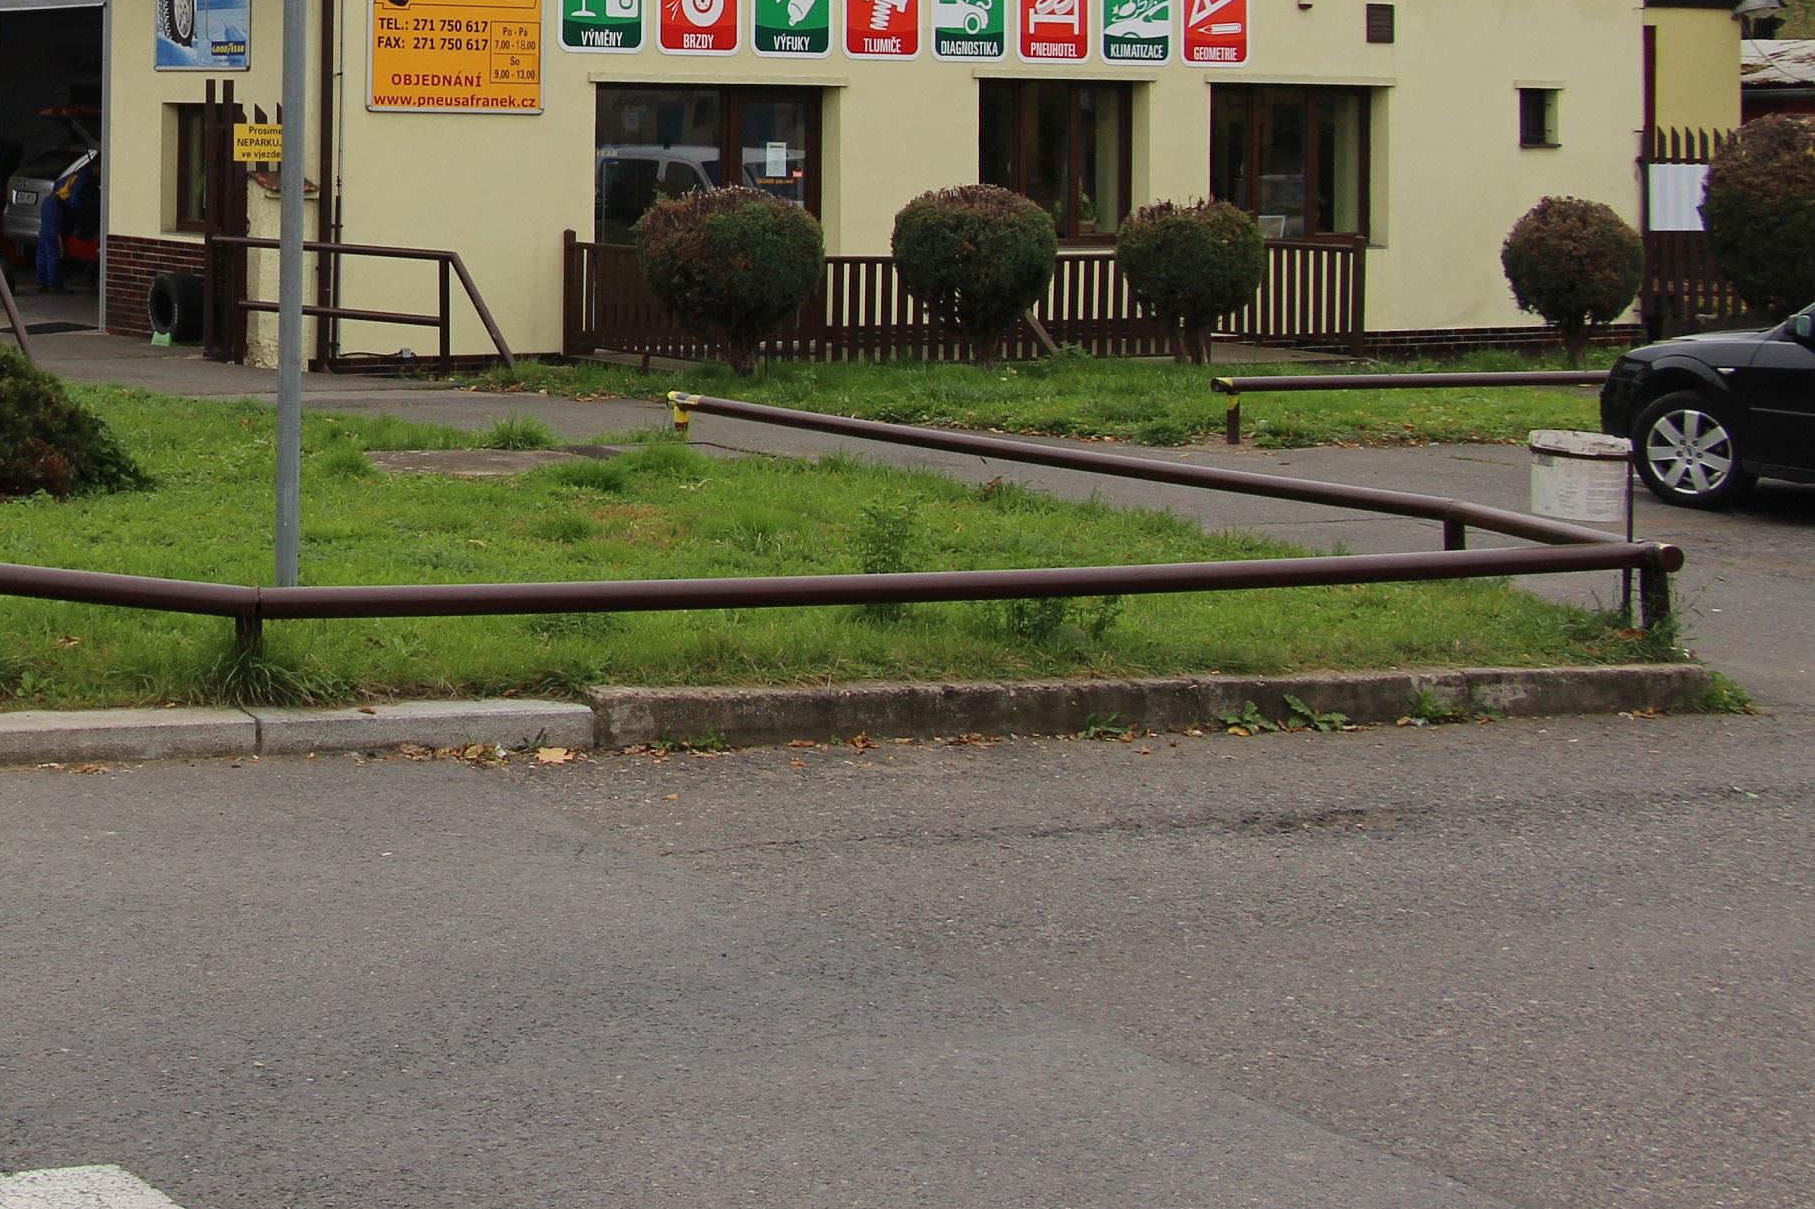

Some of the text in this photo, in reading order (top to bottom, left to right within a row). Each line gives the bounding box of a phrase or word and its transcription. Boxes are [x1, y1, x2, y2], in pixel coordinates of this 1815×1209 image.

[379, 18, 488, 33] TEL.: 271 750 617
[502, 27, 512, 36] Po
[519, 26, 528, 36] Pá
[378, 36, 488, 51] FAX: 271 750 617
[495, 40, 510, 50] 7,00
[581, 30, 623, 48] VÝMĚNY
[683, 34, 715, 49] BRZDY
[773, 33, 810, 51] VÝFUKY
[863, 36, 902, 53] TLUMIČE
[212, 43, 245, 54] GOODYEAR
[940, 40, 998, 56] DIAGNOSTIKA
[1030, 42, 1078, 57] PNEUHOTEL
[1110, 43, 1163, 59] KLIMATIZACE
[1193, 46, 1237, 61] GEOMETRIE
[510, 56, 520, 66] So
[391, 71, 482, 87] OBJEDNÁNÍ
[494, 69, 510, 79] 9,00
[516, 70, 536, 80] 13,00
[374, 95, 536, 108] www.pneusafranek.cz
[237, 138, 282, 147] NEPARKU
